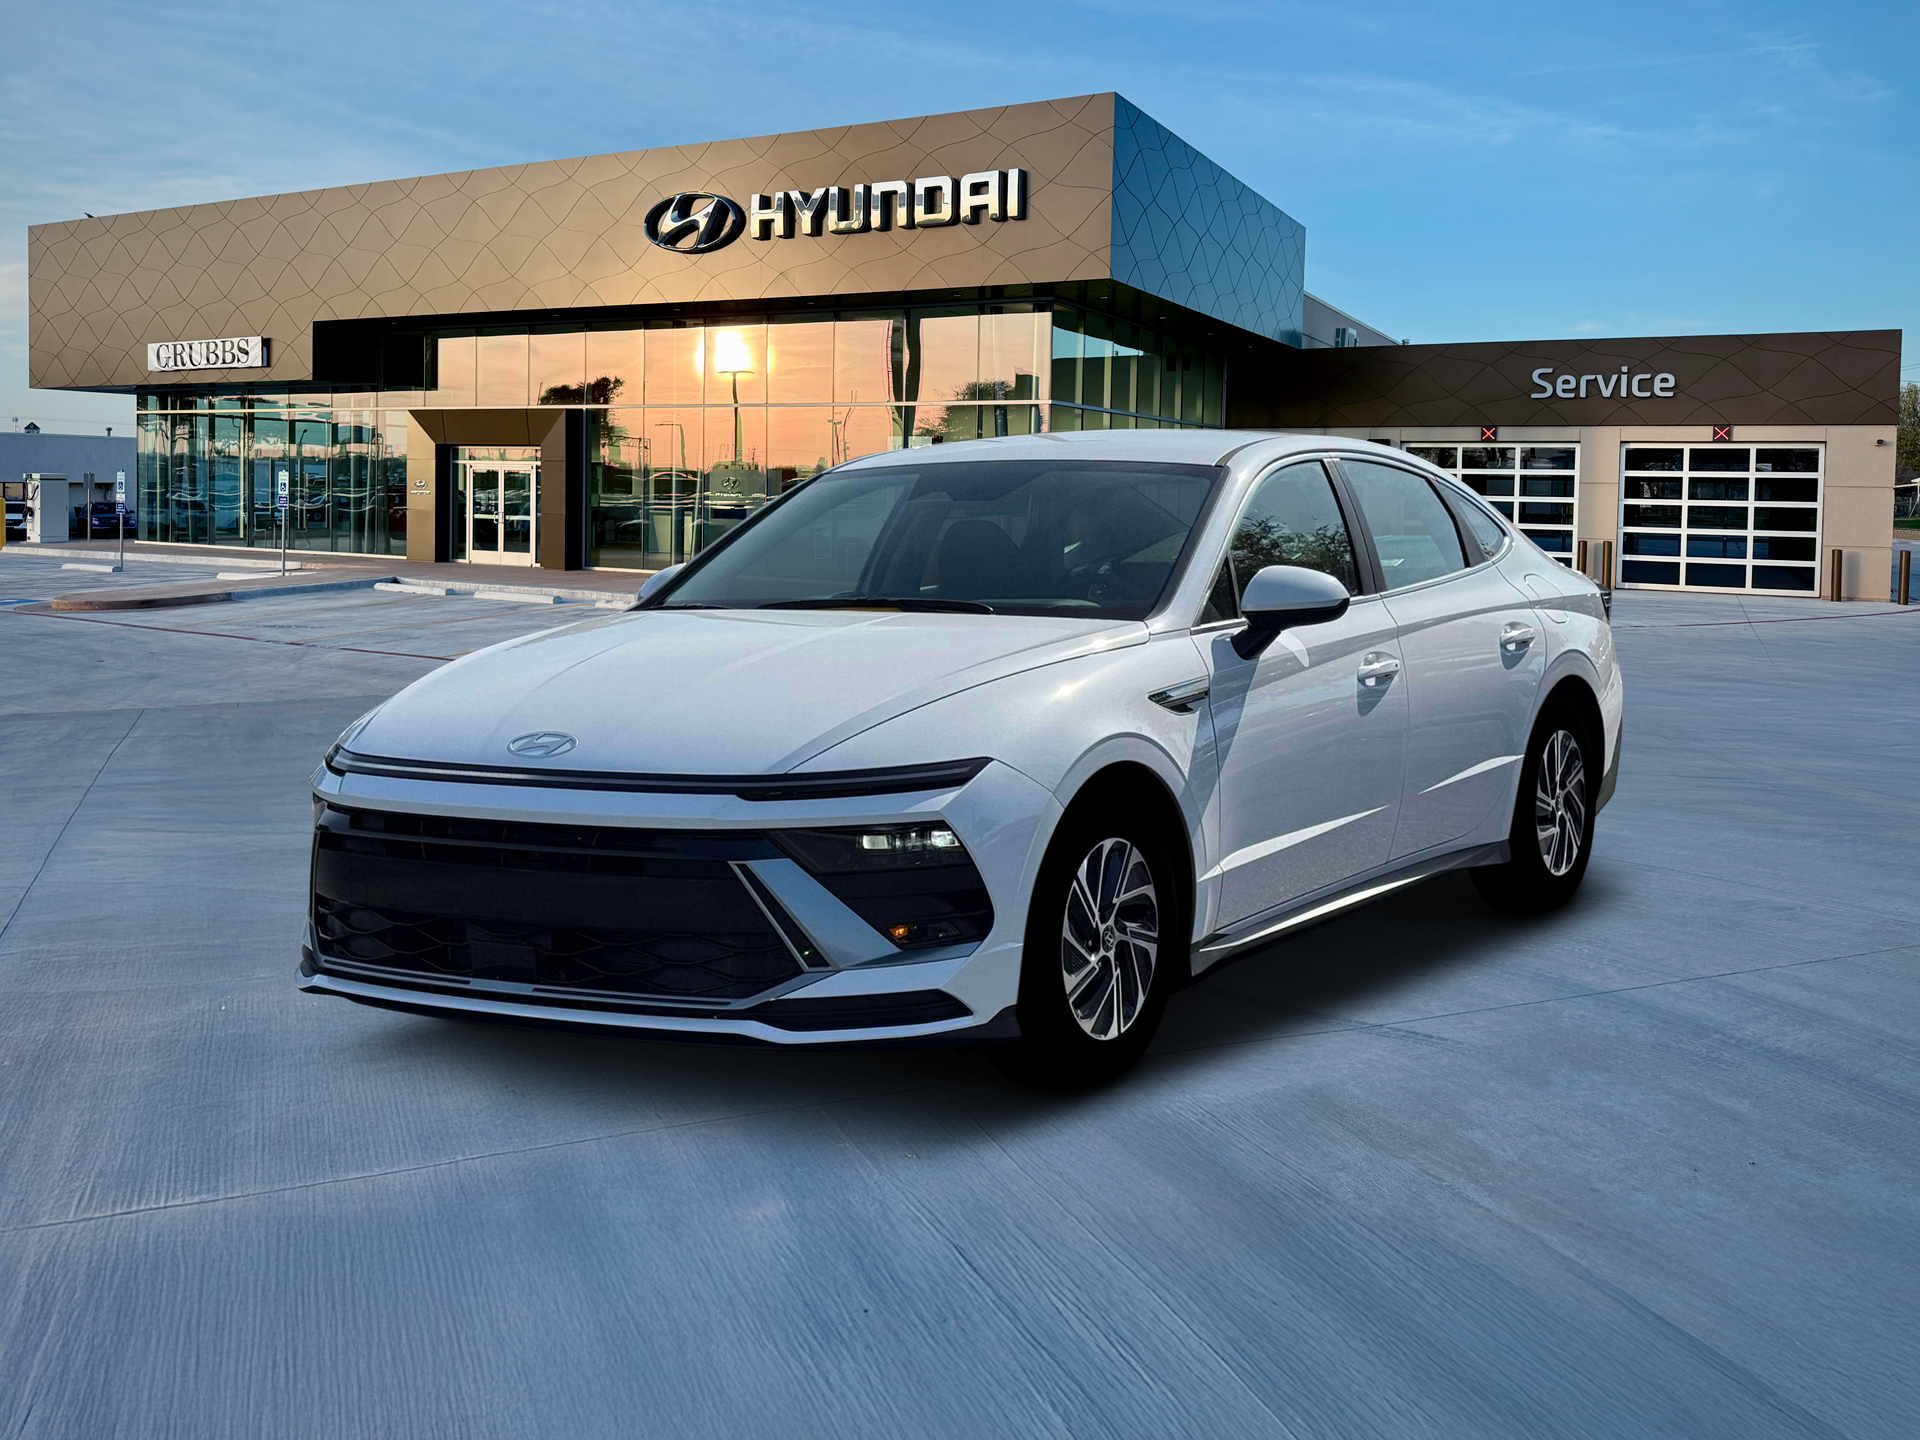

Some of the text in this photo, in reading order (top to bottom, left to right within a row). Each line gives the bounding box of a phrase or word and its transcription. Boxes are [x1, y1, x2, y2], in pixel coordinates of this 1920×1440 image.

[750, 168, 1025, 240] HYUNDAI
[156, 338, 249, 369] GRUBBS
[1530, 365, 1676, 399] Service
